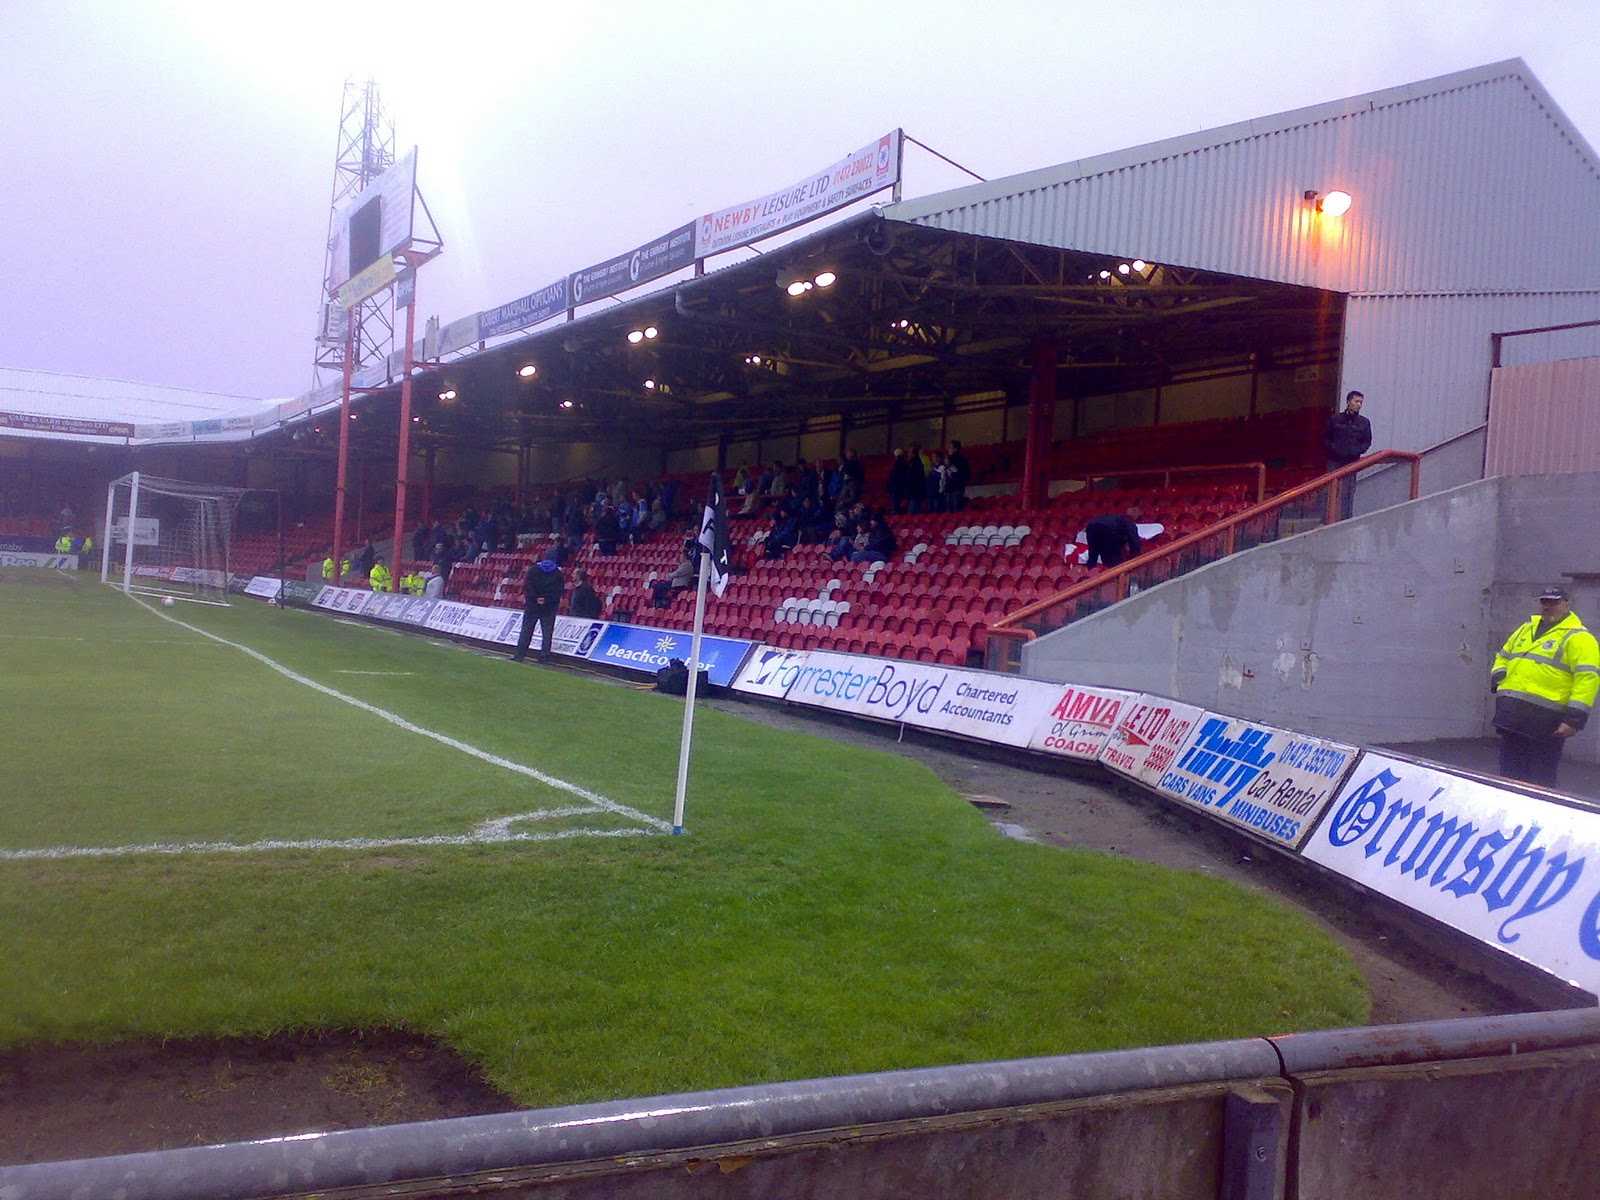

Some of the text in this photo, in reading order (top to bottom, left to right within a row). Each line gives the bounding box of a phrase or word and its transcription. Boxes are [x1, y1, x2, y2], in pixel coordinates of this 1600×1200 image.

[714, 204, 761, 233] NEWBY
[762, 184, 807, 216] LEISURE
[809, 175, 830, 199] LTD
[530, 283, 563, 309] OPTICIANS
[939, 700, 1014, 725] Accountants
[956, 682, 1018, 706] Chartered
[1139, 708, 1171, 741] LTD
[1160, 718, 1190, 745] 01472
[1044, 736, 1099, 756] COACH
[1103, 747, 1136, 770] TRAVEL
[1177, 718, 1346, 808] Thrifty 01472 355700
[1161, 772, 1301, 841] CARS VANS MINIBUSES
[1247, 770, 1326, 816] Car Rental
[1328, 767, 1586, 944] Grimsby
